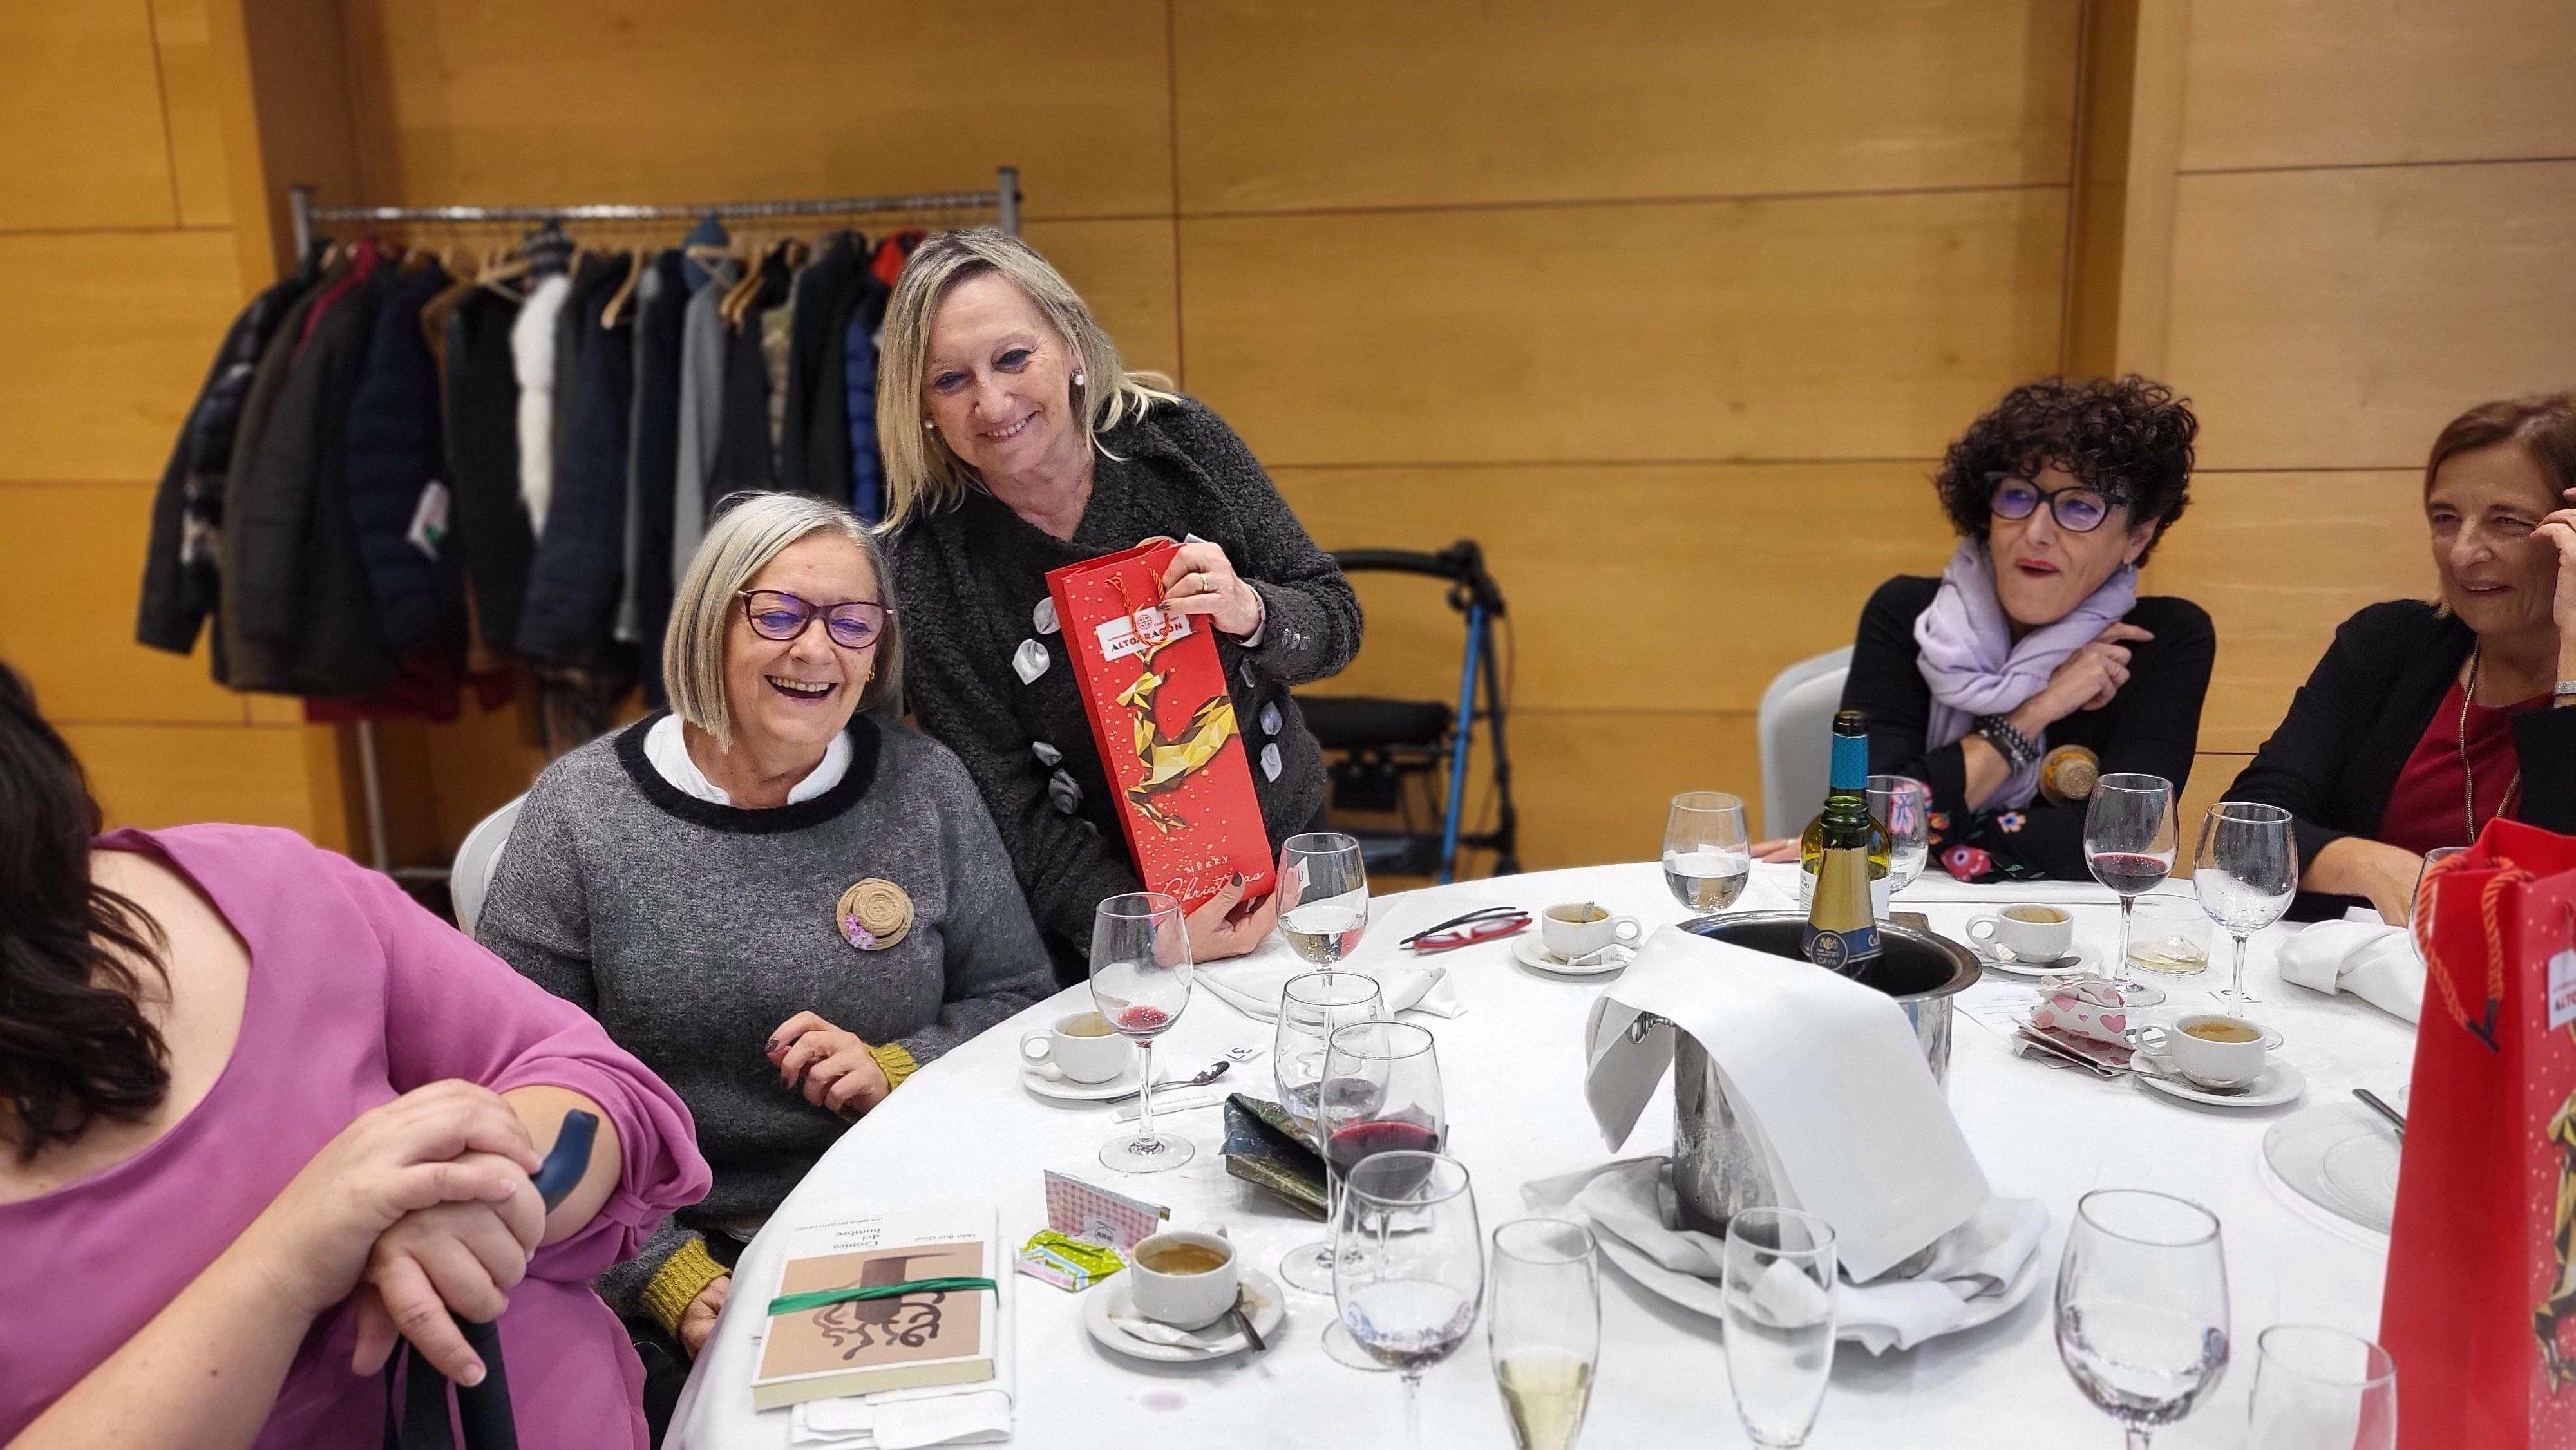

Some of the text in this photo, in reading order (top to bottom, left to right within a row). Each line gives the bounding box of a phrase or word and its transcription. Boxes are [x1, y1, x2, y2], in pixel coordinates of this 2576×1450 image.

[1111, 622, 1183, 652] ALTORAGON
[1186, 854, 1229, 874] MERRY
[1157, 871, 1265, 908] Christas
[1817, 957, 1837, 966] CAVA
[836, 1228, 880, 1236] hombre
